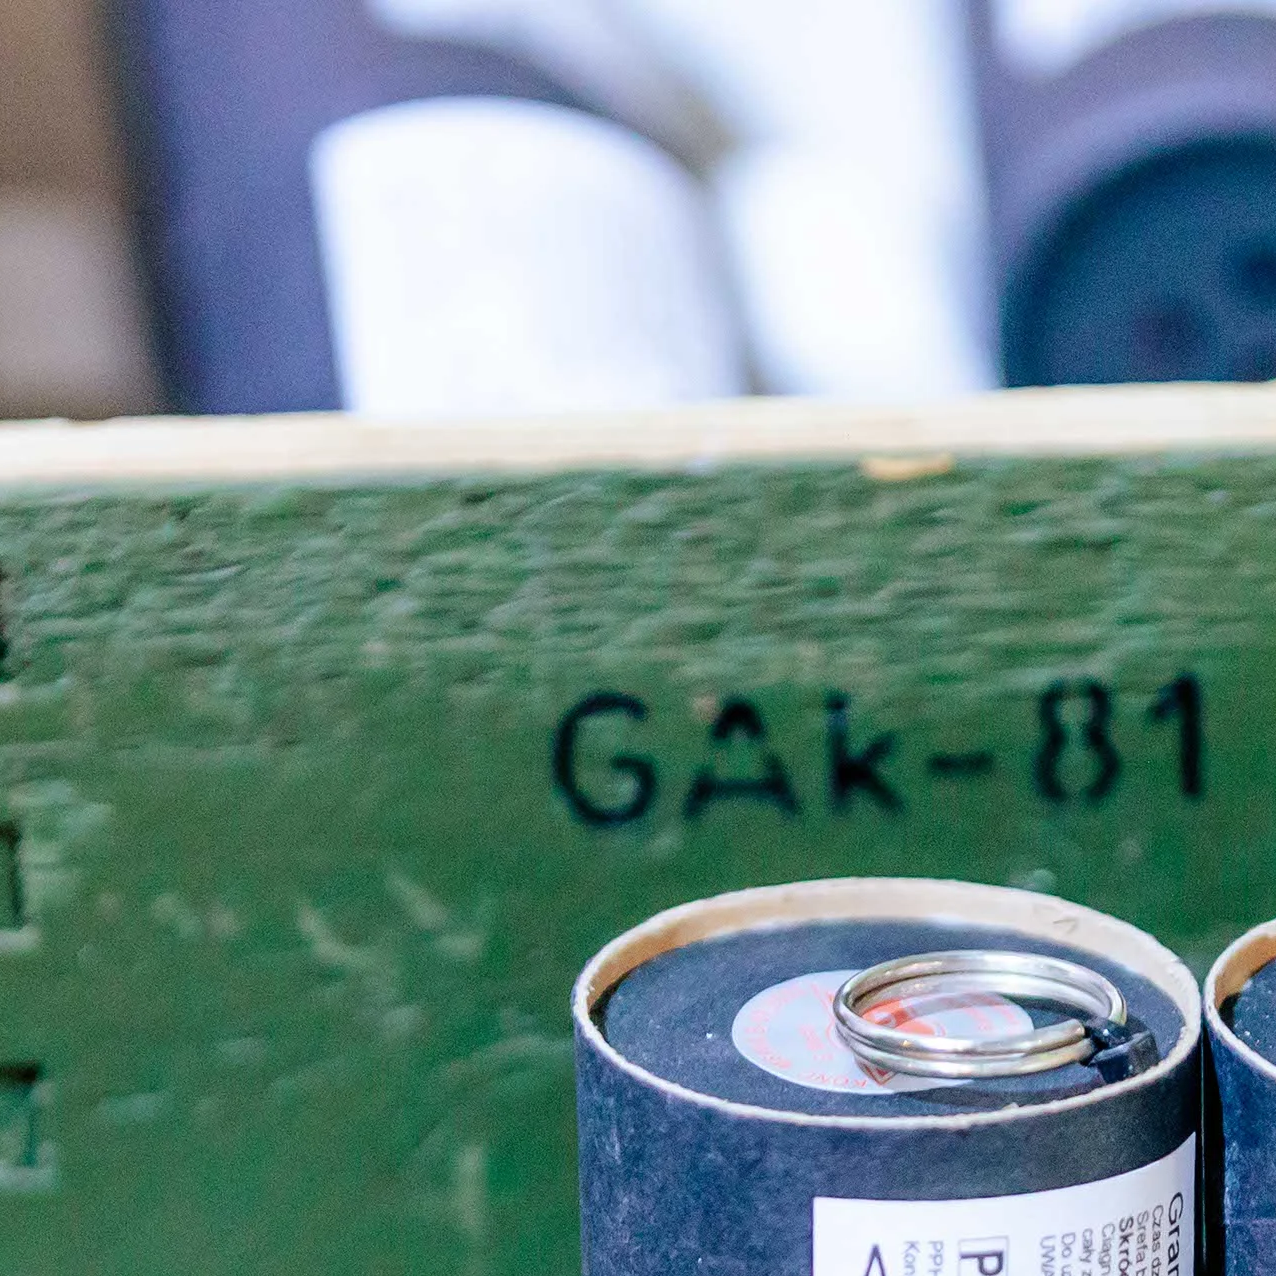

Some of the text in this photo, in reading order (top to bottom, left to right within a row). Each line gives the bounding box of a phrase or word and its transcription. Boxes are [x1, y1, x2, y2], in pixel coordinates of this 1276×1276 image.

[550, 672, 1205, 829] GAk-81
[1061, 1232, 1076, 1257] Do
[1079, 1229, 1095, 1263] cały
[1151, 1205, 1164, 1252] Czas
